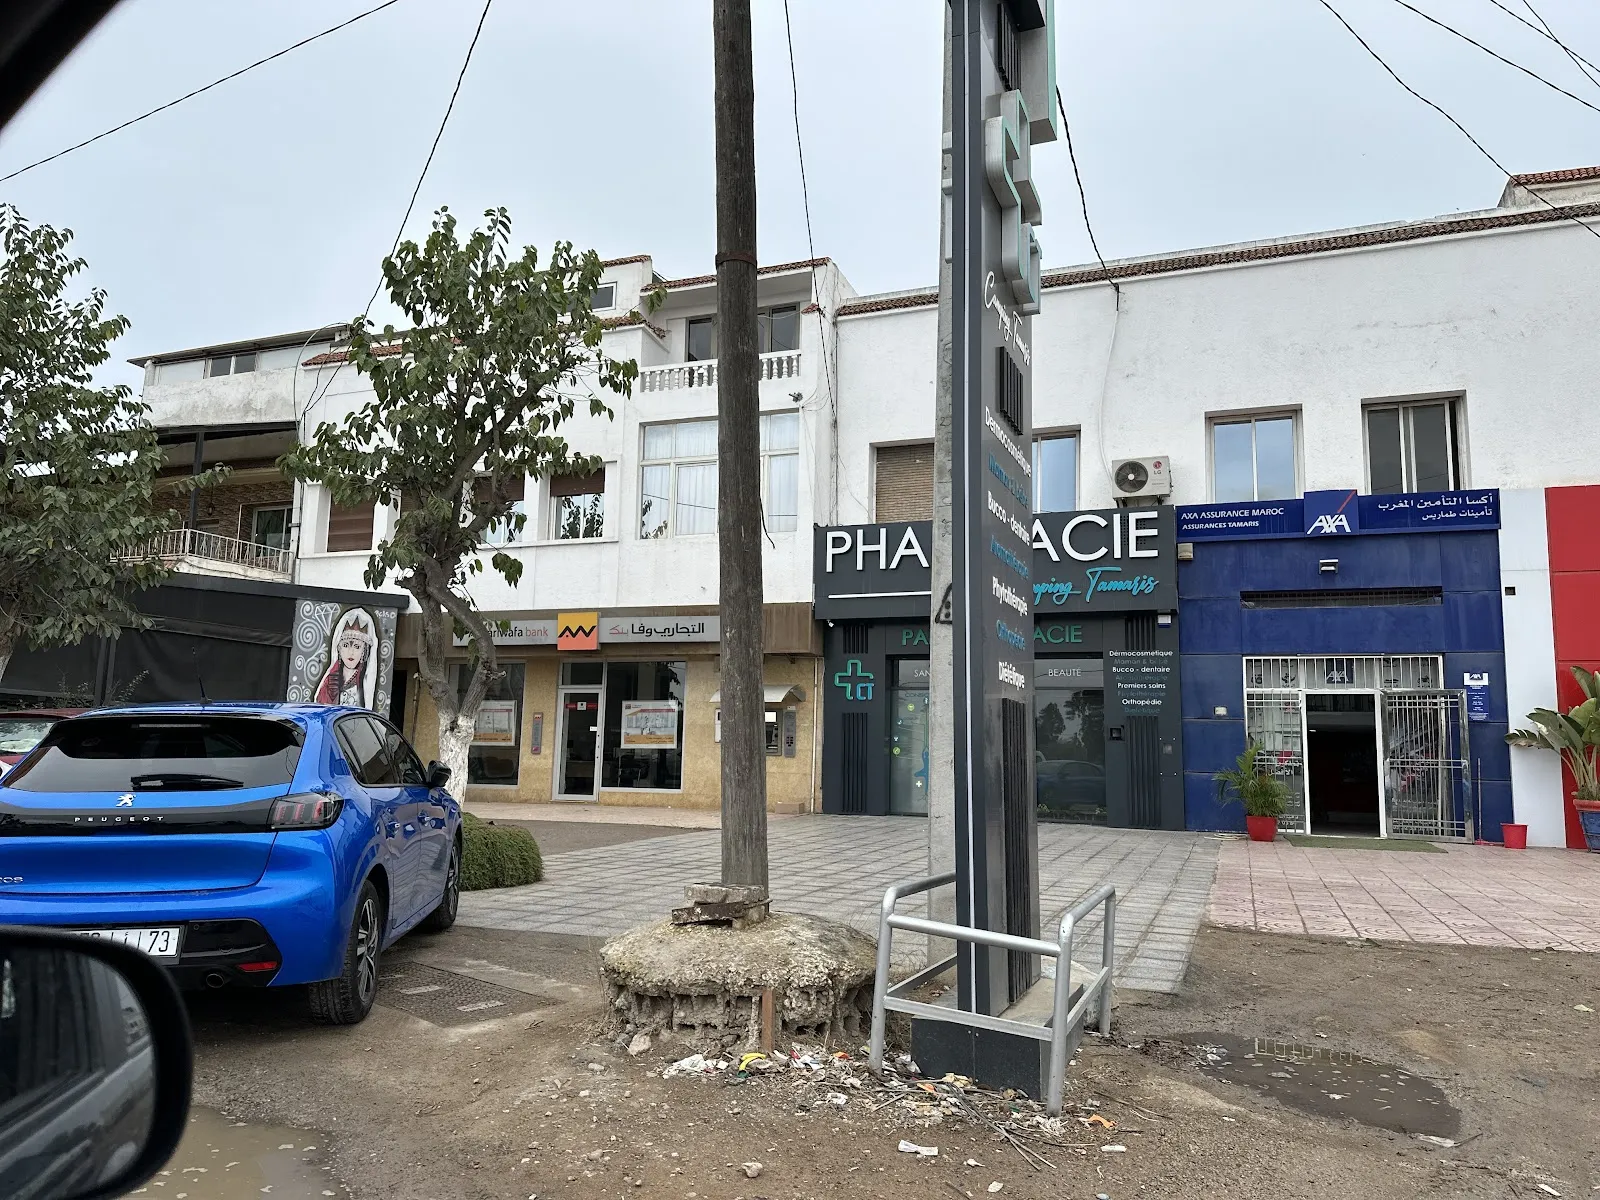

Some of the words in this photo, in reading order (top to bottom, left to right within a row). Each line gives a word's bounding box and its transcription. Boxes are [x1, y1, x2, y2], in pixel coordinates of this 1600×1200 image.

[1417, 495, 1462, 509] التأمين
[1466, 493, 1493, 504] أكسا
[1378, 499, 1414, 511] المغرب
[988, 490, 1006, 524] Bucco
[1010, 513, 1030, 547] dentaire
[1200, 509, 1249, 519] ASSURANCE
[1251, 507, 1285, 516] MAROC
[1459, 508, 1493, 518] تأمينات
[1182, 522, 1227, 530] ASSURANCES
[1228, 520, 1260, 528] TAMARIS
[1307, 514, 1352, 534] AXA
[826, 511, 1158, 573] PHAACIE
[1033, 577, 1082, 606] ping
[1086, 566, 1160, 603] Tamaris
[992, 576, 1028, 616] Phytothérapie
[525, 626, 549, 638] bank
[609, 624, 629, 637] بنك
[654, 622, 705, 637] التجاري
[914, 669, 930, 678] SAN
[998, 661, 1025, 692] Diététique
[1048, 667, 1081, 677] BEAUTÉ
[1326, 671, 1349, 682] AXA
[1122, 698, 1162, 706] Orthopédie
[148, 930, 170, 952] 73
